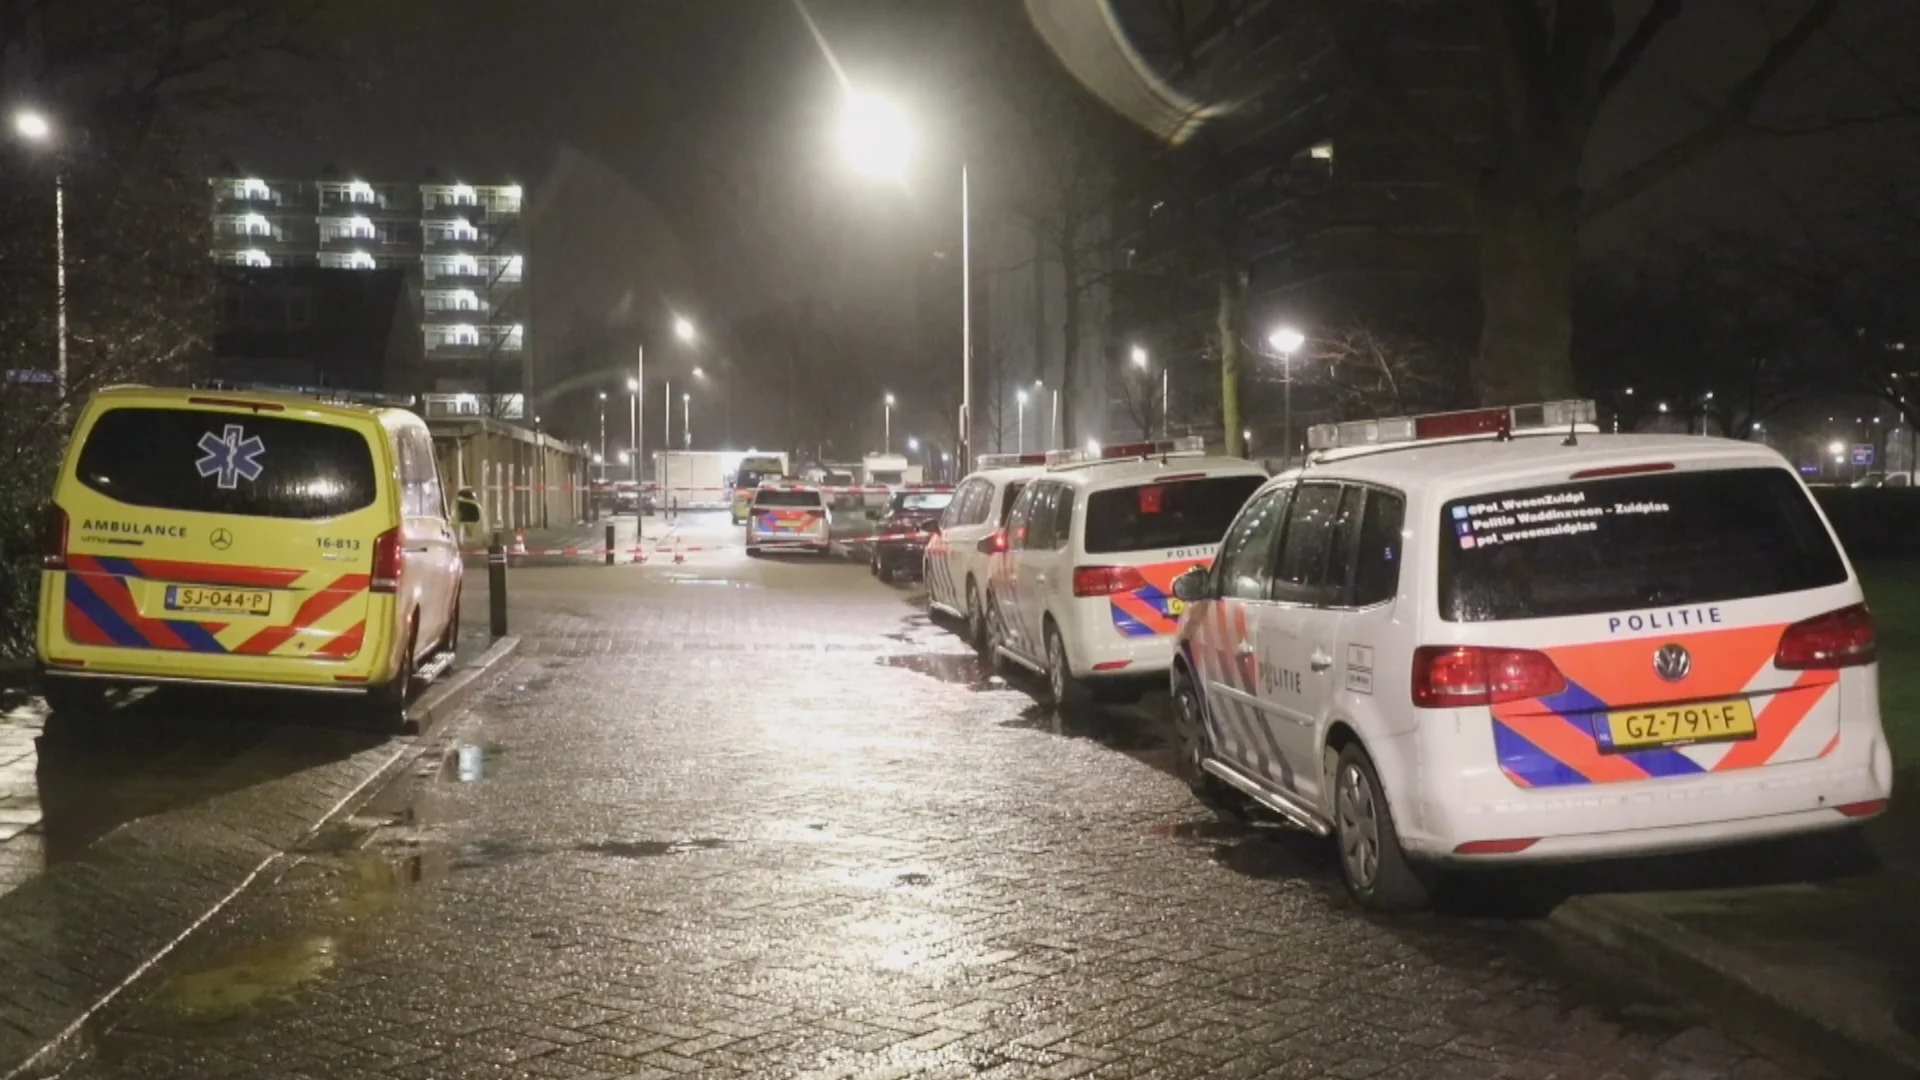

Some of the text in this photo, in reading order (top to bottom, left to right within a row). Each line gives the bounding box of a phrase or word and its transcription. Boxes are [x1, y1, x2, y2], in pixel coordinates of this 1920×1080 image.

[1473, 515, 1515, 531] Politie
[1517, 507, 1604, 524] Waddinxveen
[1614, 501, 1670, 515] Zuidplas
[83, 519, 187, 538] AMBULANCE
[1477, 522, 1598, 548] pol_wveenzuidplas
[316, 537, 360, 551] 16-813
[1167, 546, 1214, 559] POLITI
[182, 588, 263, 609] SJ-044-P
[1609, 607, 1721, 633] POLITIE
[1626, 705, 1735, 739] GZ-791-F
